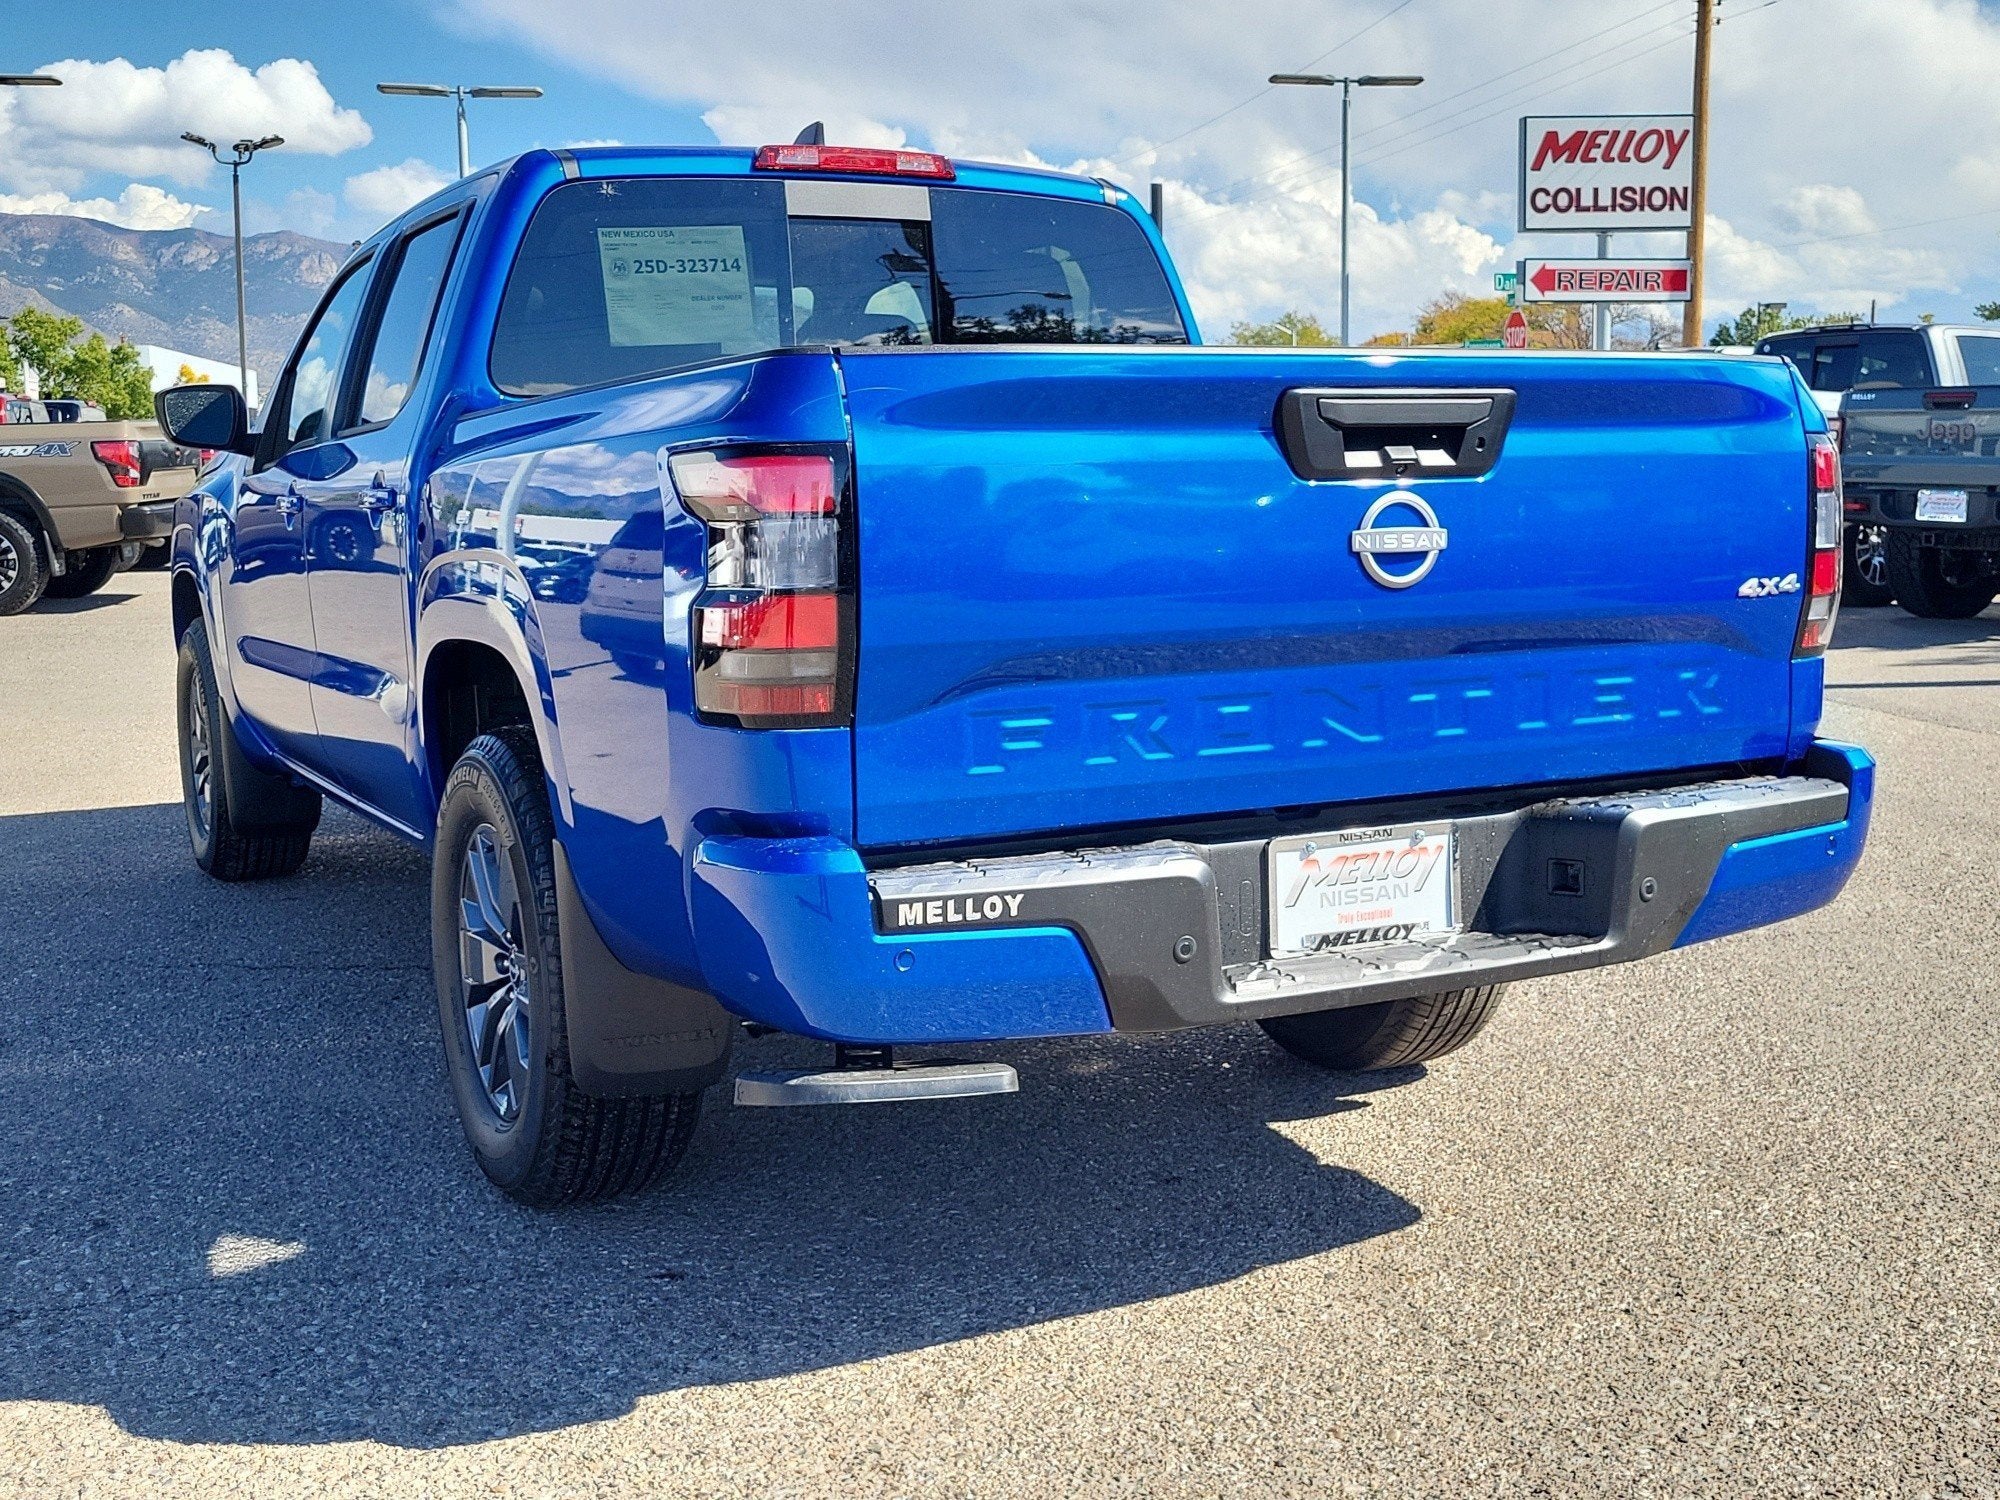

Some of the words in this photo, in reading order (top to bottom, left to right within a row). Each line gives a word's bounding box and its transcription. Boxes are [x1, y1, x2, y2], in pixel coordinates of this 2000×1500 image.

[1530, 129, 1690, 171] MELLOY
[1530, 186, 1688, 213] COLLISION
[601, 230, 621, 238] NEW
[623, 230, 655, 238] MEXICO
[657, 230, 675, 238] USA
[633, 258, 742, 274] 25D-323714
[1556, 270, 1663, 291] REPAIR
[1506, 326, 1525, 347] STOP
[1917, 416, 1975, 443] Jeep
[1355, 532, 1446, 550] NISSAN
[967, 662, 1724, 775] FRONTIER
[1339, 828, 1393, 843] NISSAN
[1285, 845, 1444, 908] MELLOY
[1319, 882, 1409, 909] NISSAN
[898, 893, 1025, 926] MELLOY
[1337, 911, 1354, 924] Truly
[1314, 922, 1417, 951] MELLOY
